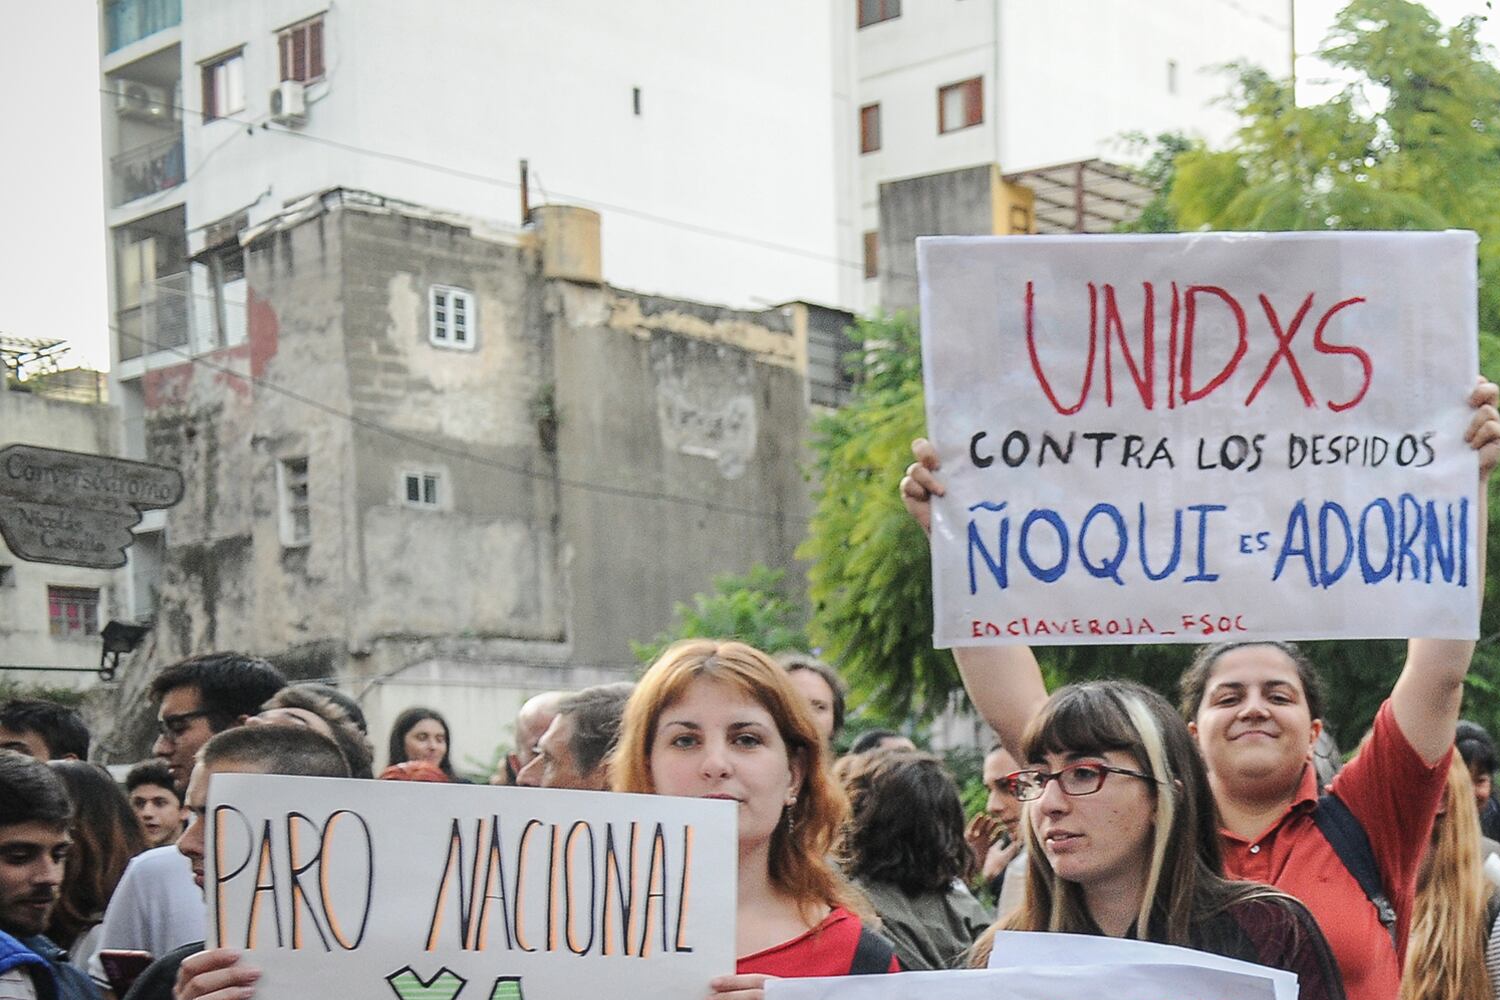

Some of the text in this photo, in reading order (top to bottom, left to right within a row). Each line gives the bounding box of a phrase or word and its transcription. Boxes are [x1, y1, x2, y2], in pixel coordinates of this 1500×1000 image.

[1025, 281, 1372, 415] UNIDXS
[970, 430, 1436, 470] CONTRA LOS DESPIDOS
[967, 493, 1468, 595] ÑOQUI ES ADORNI
[214, 805, 694, 957] PARO NACIONAL
